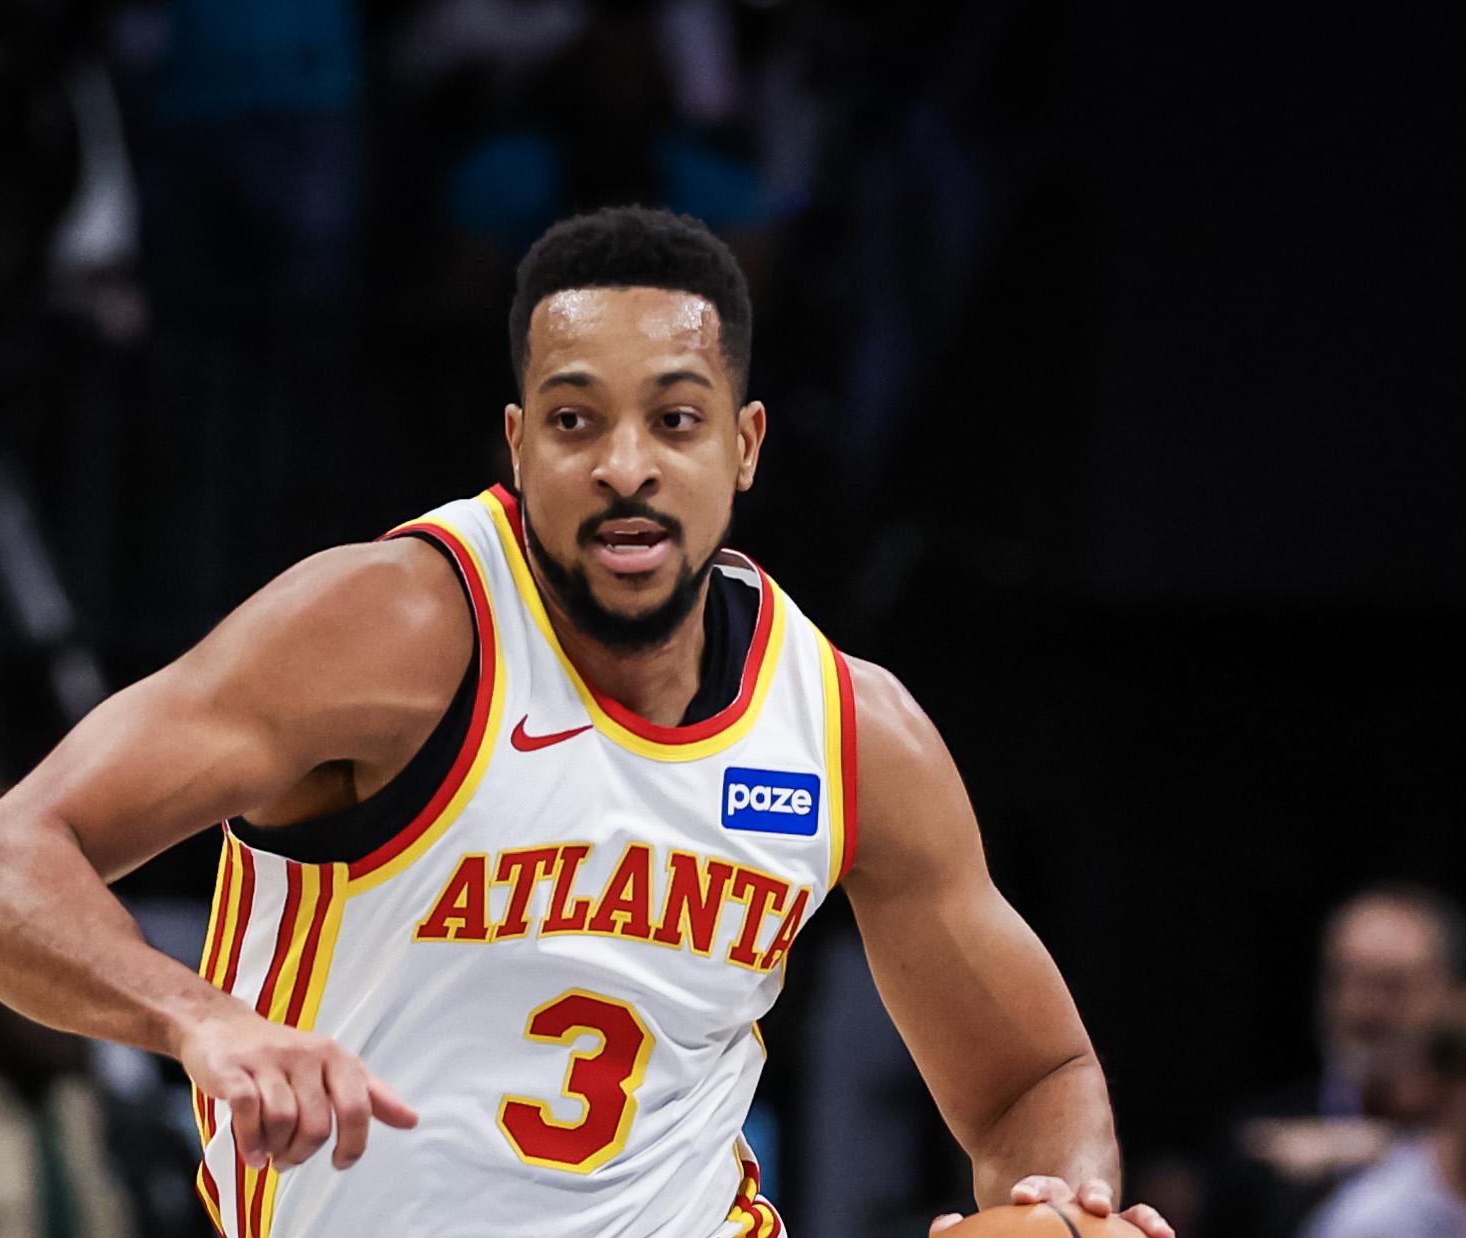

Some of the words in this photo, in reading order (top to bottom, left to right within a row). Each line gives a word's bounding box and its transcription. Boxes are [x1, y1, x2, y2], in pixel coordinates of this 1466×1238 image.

[727, 782, 813, 816] paze
[414, 842, 813, 973] ATLANTA
[498, 988, 655, 1174] 3
